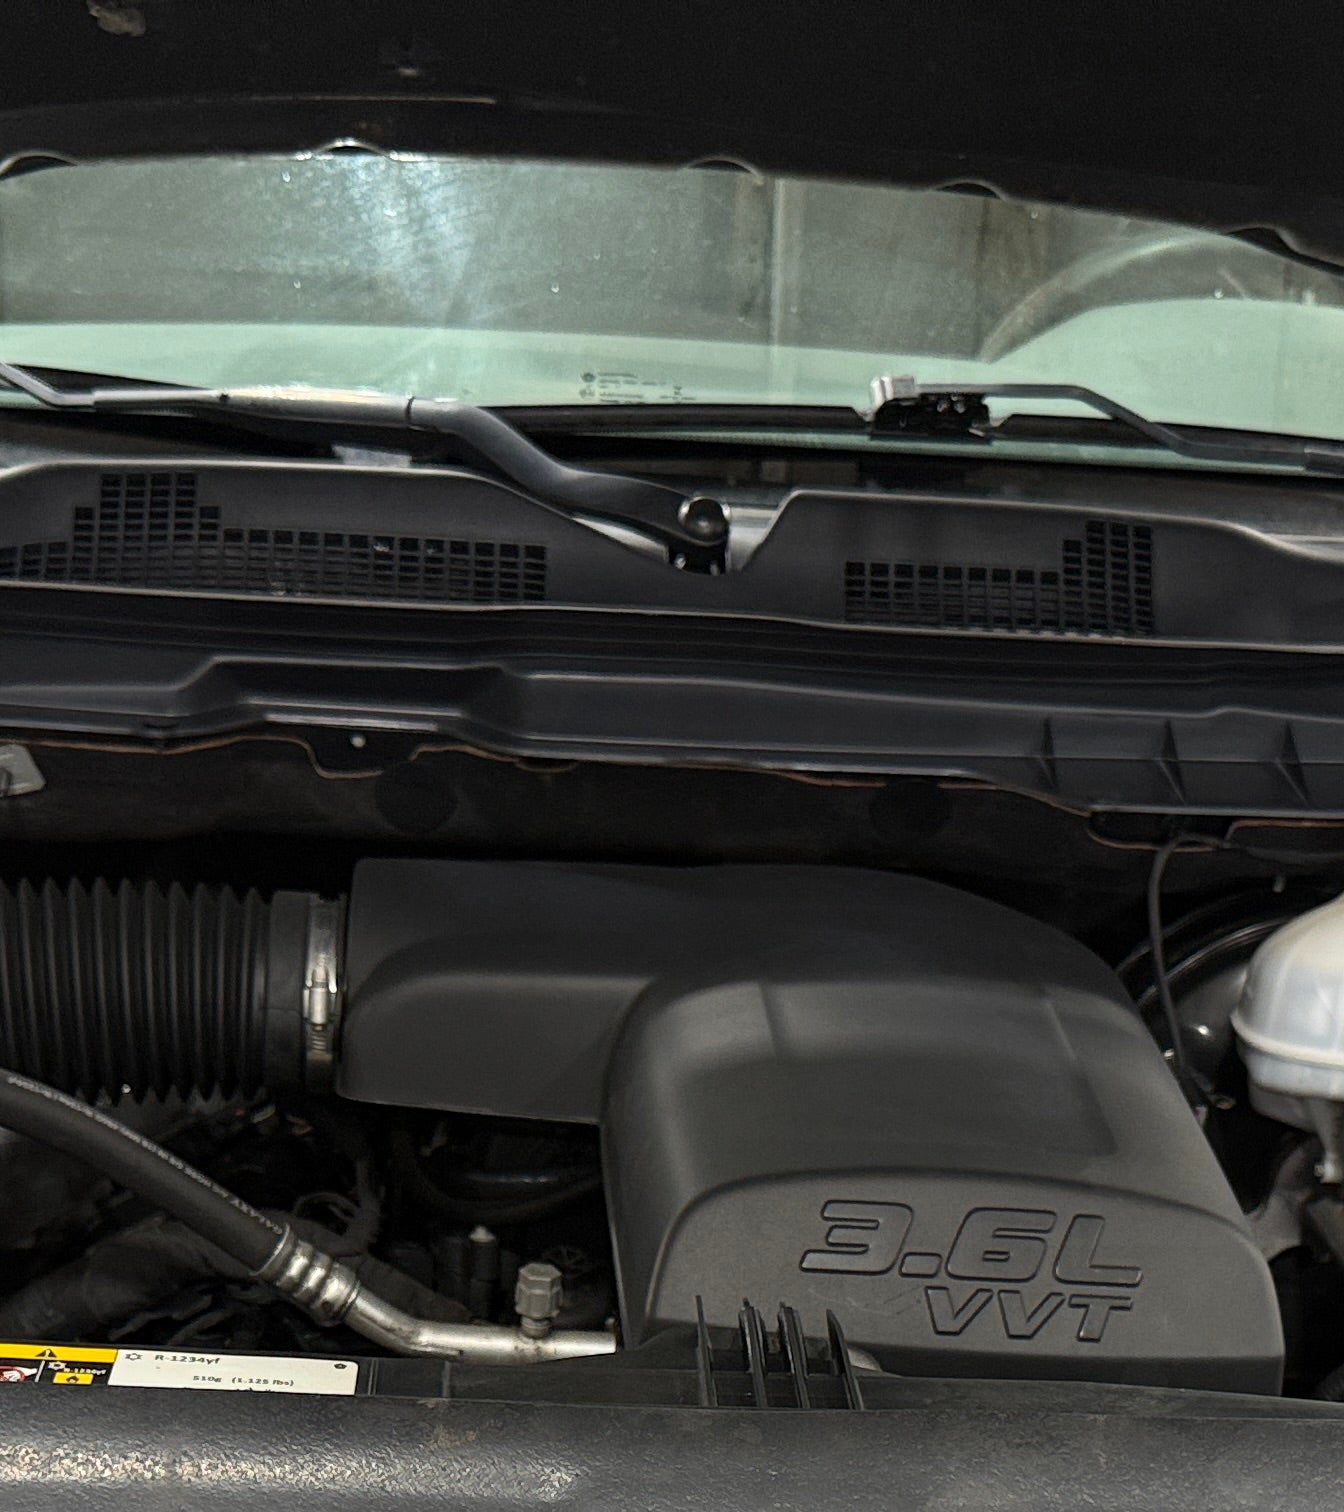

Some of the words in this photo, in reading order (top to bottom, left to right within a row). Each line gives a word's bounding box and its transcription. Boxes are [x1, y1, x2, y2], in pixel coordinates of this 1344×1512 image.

[799, 1199, 1144, 1287] 3.6L
[923, 1285, 1134, 1343] VVT
[154, 1354, 220, 1365] R-1234yf
